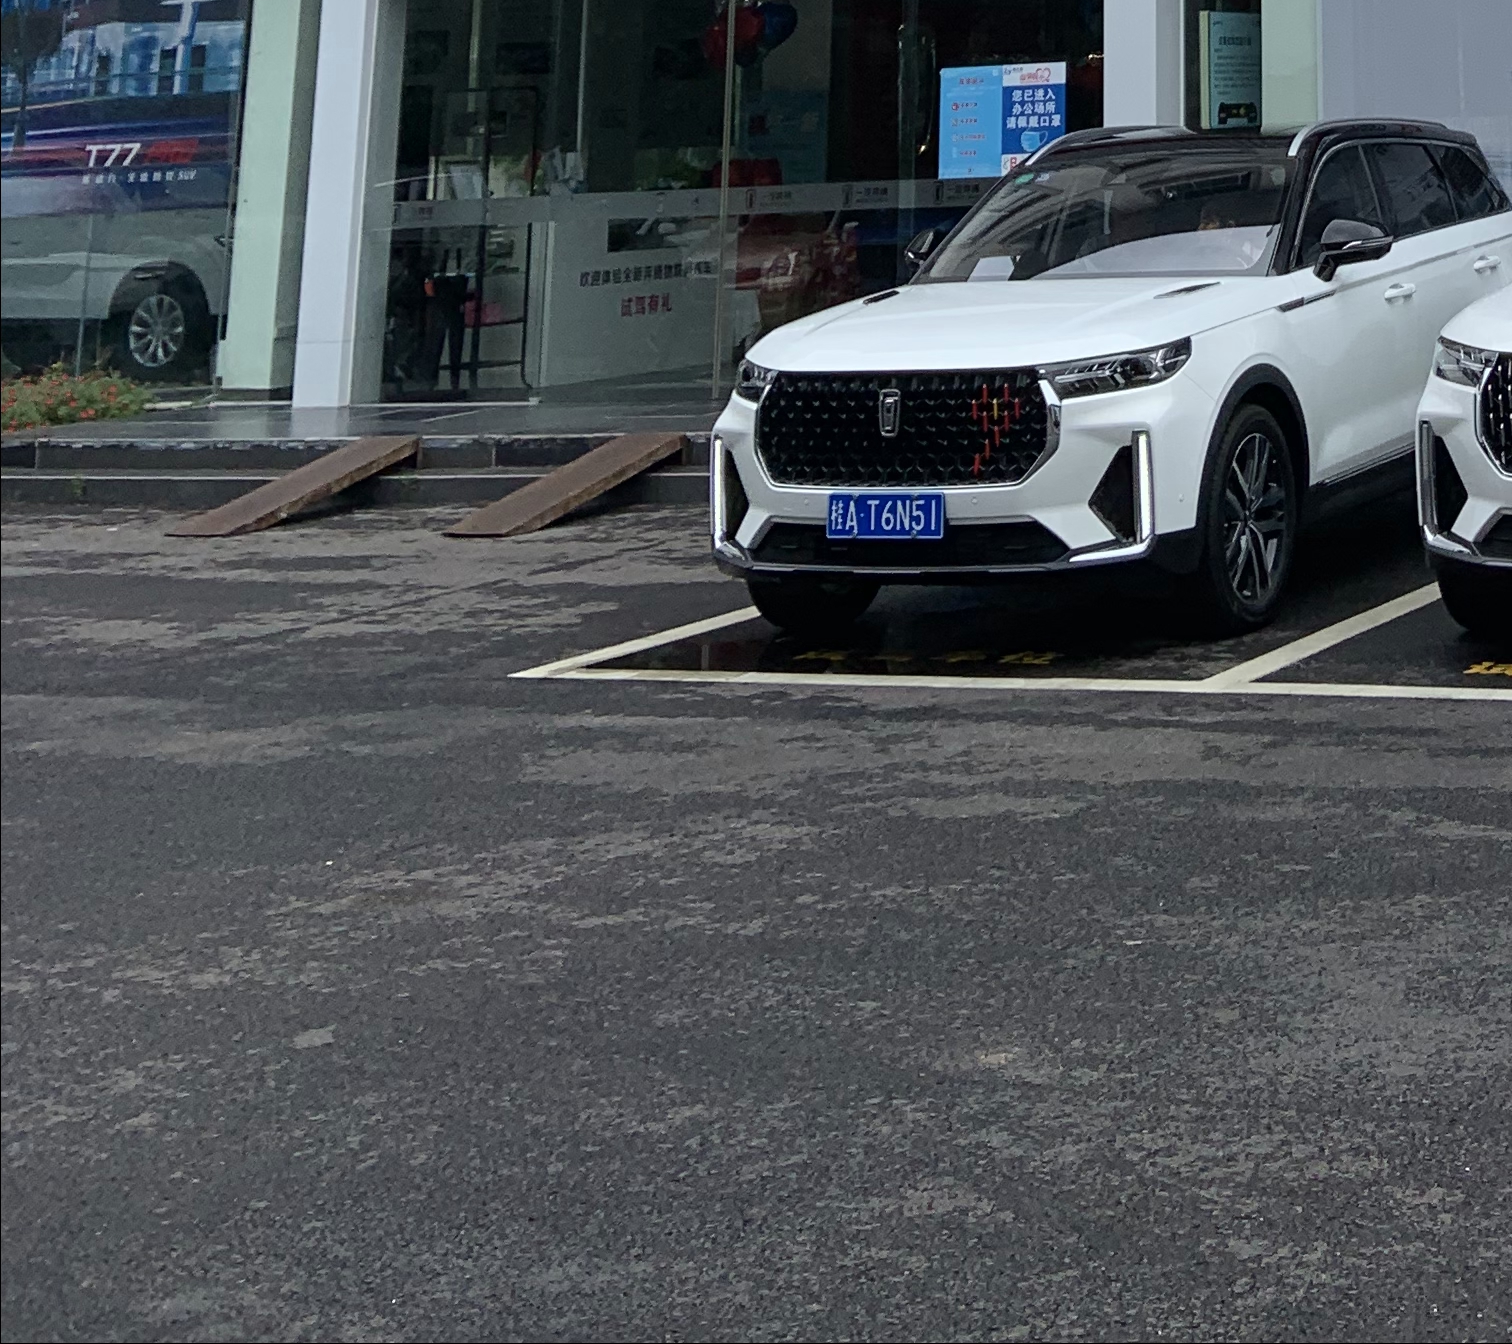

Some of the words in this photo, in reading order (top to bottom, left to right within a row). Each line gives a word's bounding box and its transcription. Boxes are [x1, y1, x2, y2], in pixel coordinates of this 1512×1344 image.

[1011, 88, 1056, 102] 您已进入
[1011, 101, 1056, 115] 办公场所
[85, 142, 141, 167] T77
